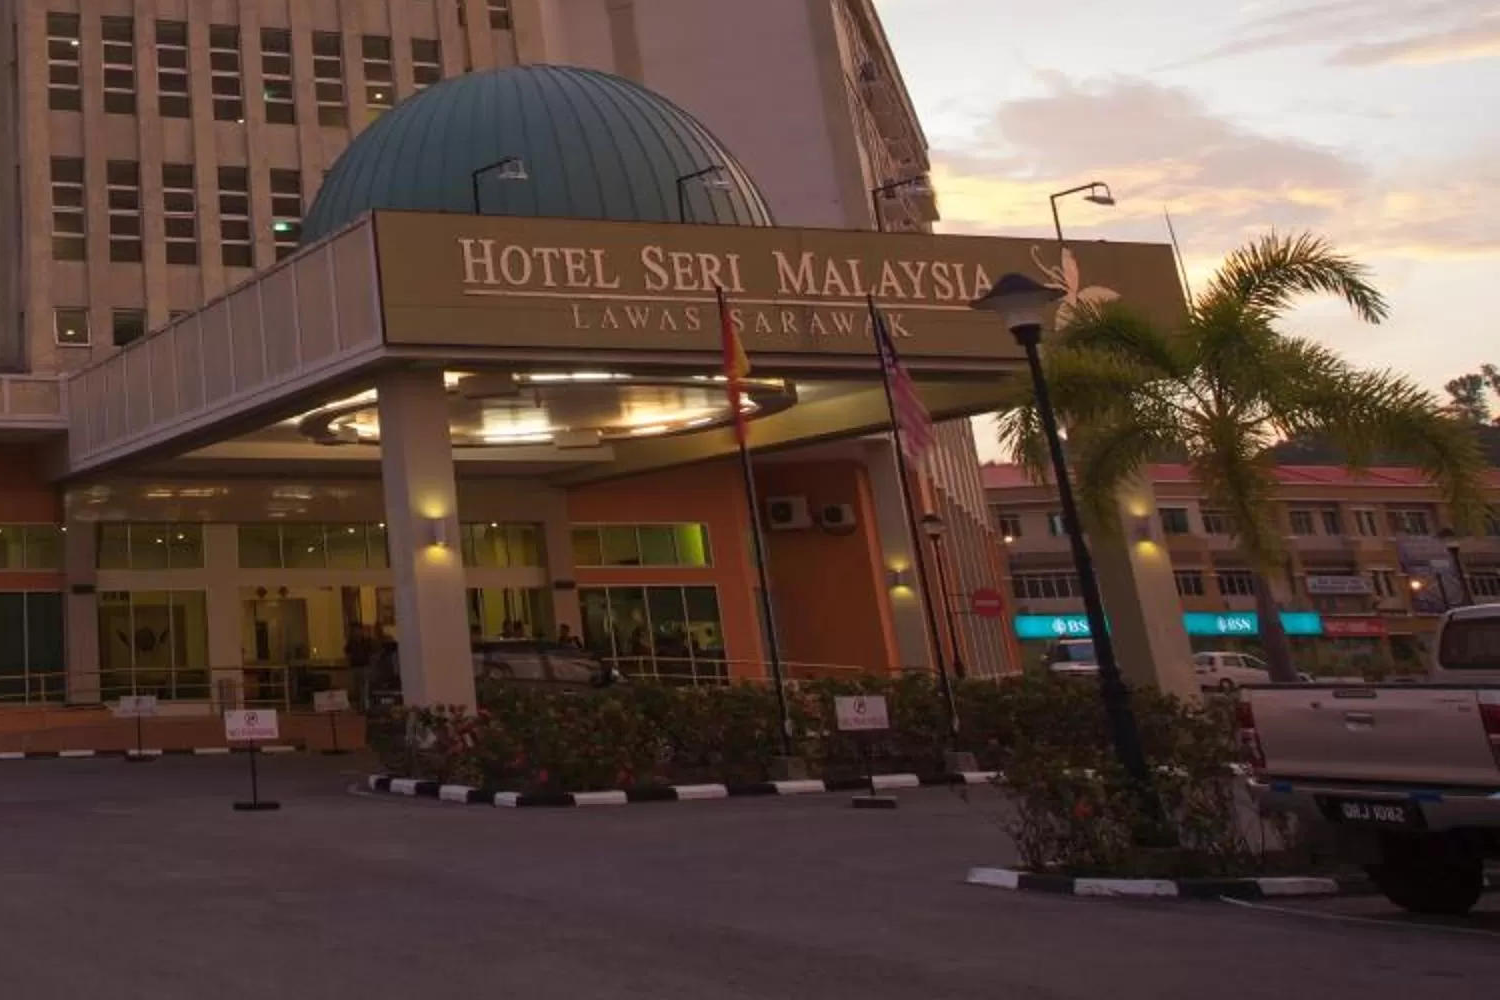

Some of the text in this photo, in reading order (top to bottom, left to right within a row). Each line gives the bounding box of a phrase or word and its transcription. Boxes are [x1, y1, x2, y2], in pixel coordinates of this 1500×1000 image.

[458, 239, 994, 302] HOTEL SERI MALAYSIA
[571, 303, 701, 331] LAWAS
[1067, 619, 1090, 634] BS
